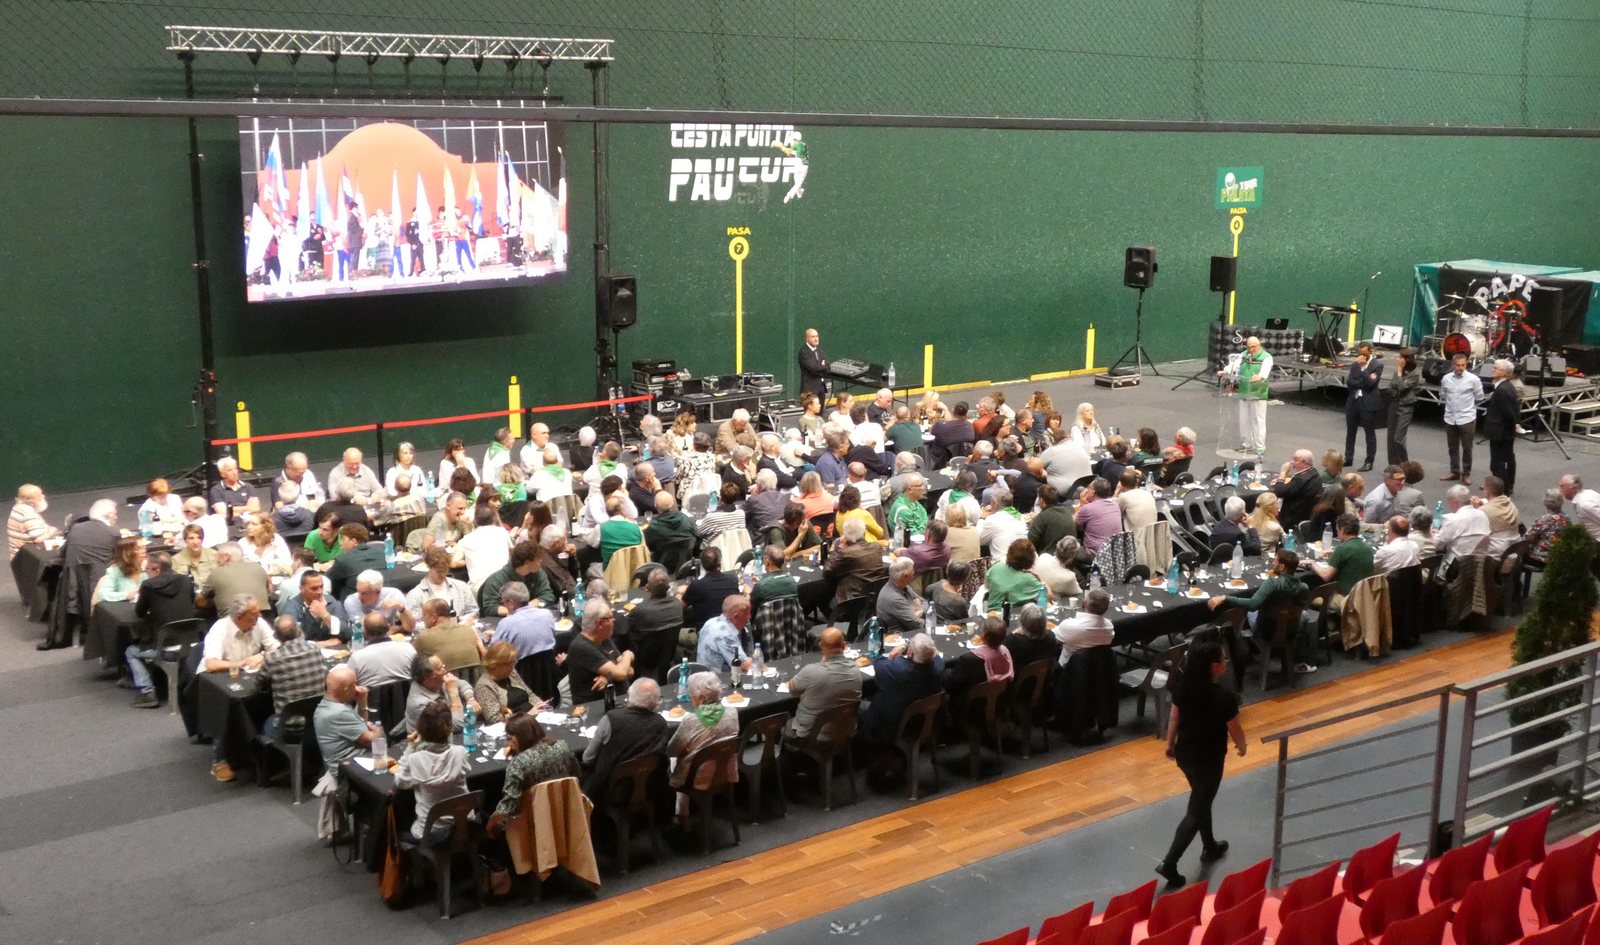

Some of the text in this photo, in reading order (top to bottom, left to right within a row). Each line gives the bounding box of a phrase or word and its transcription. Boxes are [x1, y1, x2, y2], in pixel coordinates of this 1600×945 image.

[670, 123, 796, 148] CESTA PUNTA
[668, 158, 735, 202] PAU
[727, 227, 752, 236] PASA
